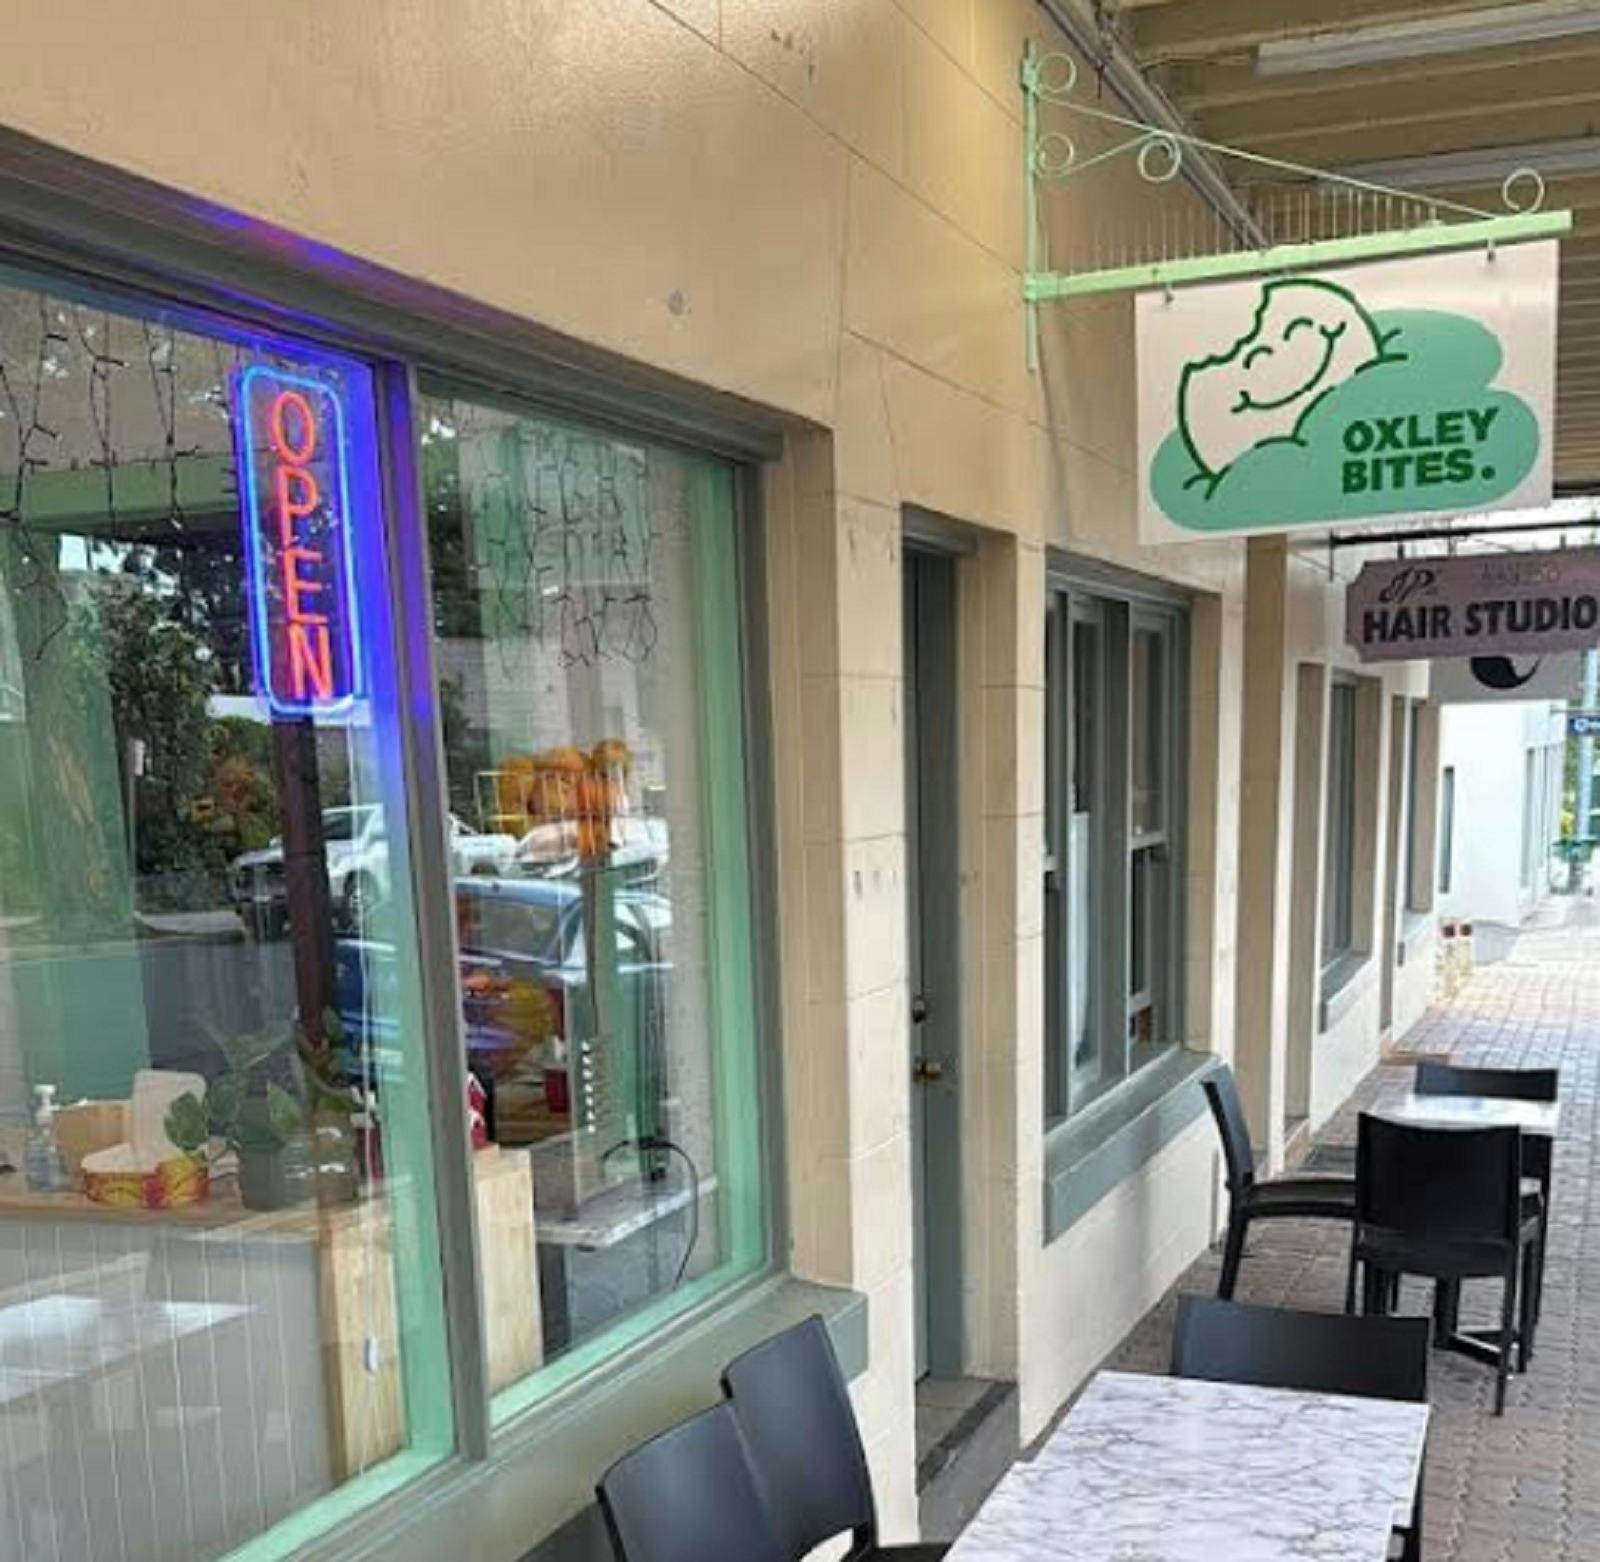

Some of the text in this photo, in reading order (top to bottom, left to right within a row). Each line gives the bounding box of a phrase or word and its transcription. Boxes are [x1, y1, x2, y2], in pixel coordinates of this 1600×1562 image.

[1343, 405, 1499, 454] OXLEY
[1343, 448, 1496, 494] BITES.
[272, 390, 334, 698] OPEN
[1363, 605, 1452, 644] HAIR
[1464, 594, 1598, 637] STUDIO
